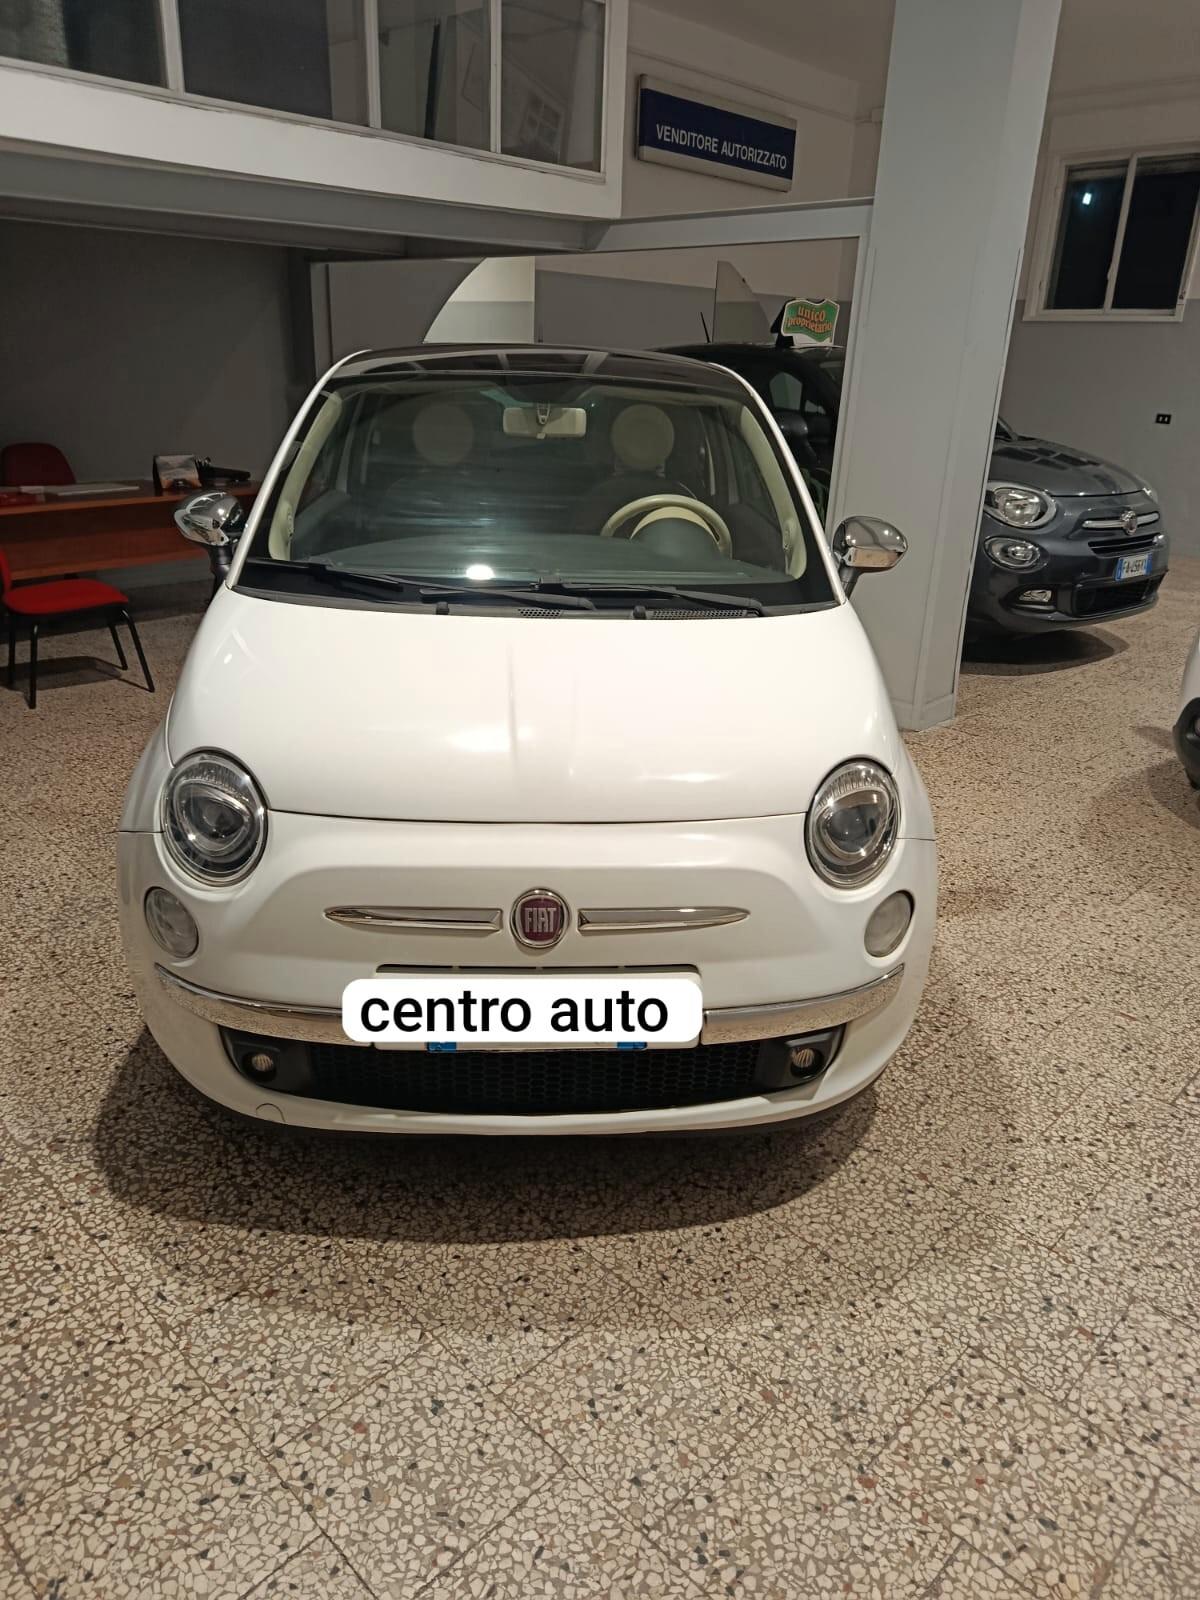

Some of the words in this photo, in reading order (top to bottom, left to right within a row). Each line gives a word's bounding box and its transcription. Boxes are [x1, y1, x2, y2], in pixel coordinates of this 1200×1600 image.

[656, 124, 719, 153] VENDITORE
[721, 140, 787, 169] AUTORIZZATO
[524, 907, 557, 933] FIAT
